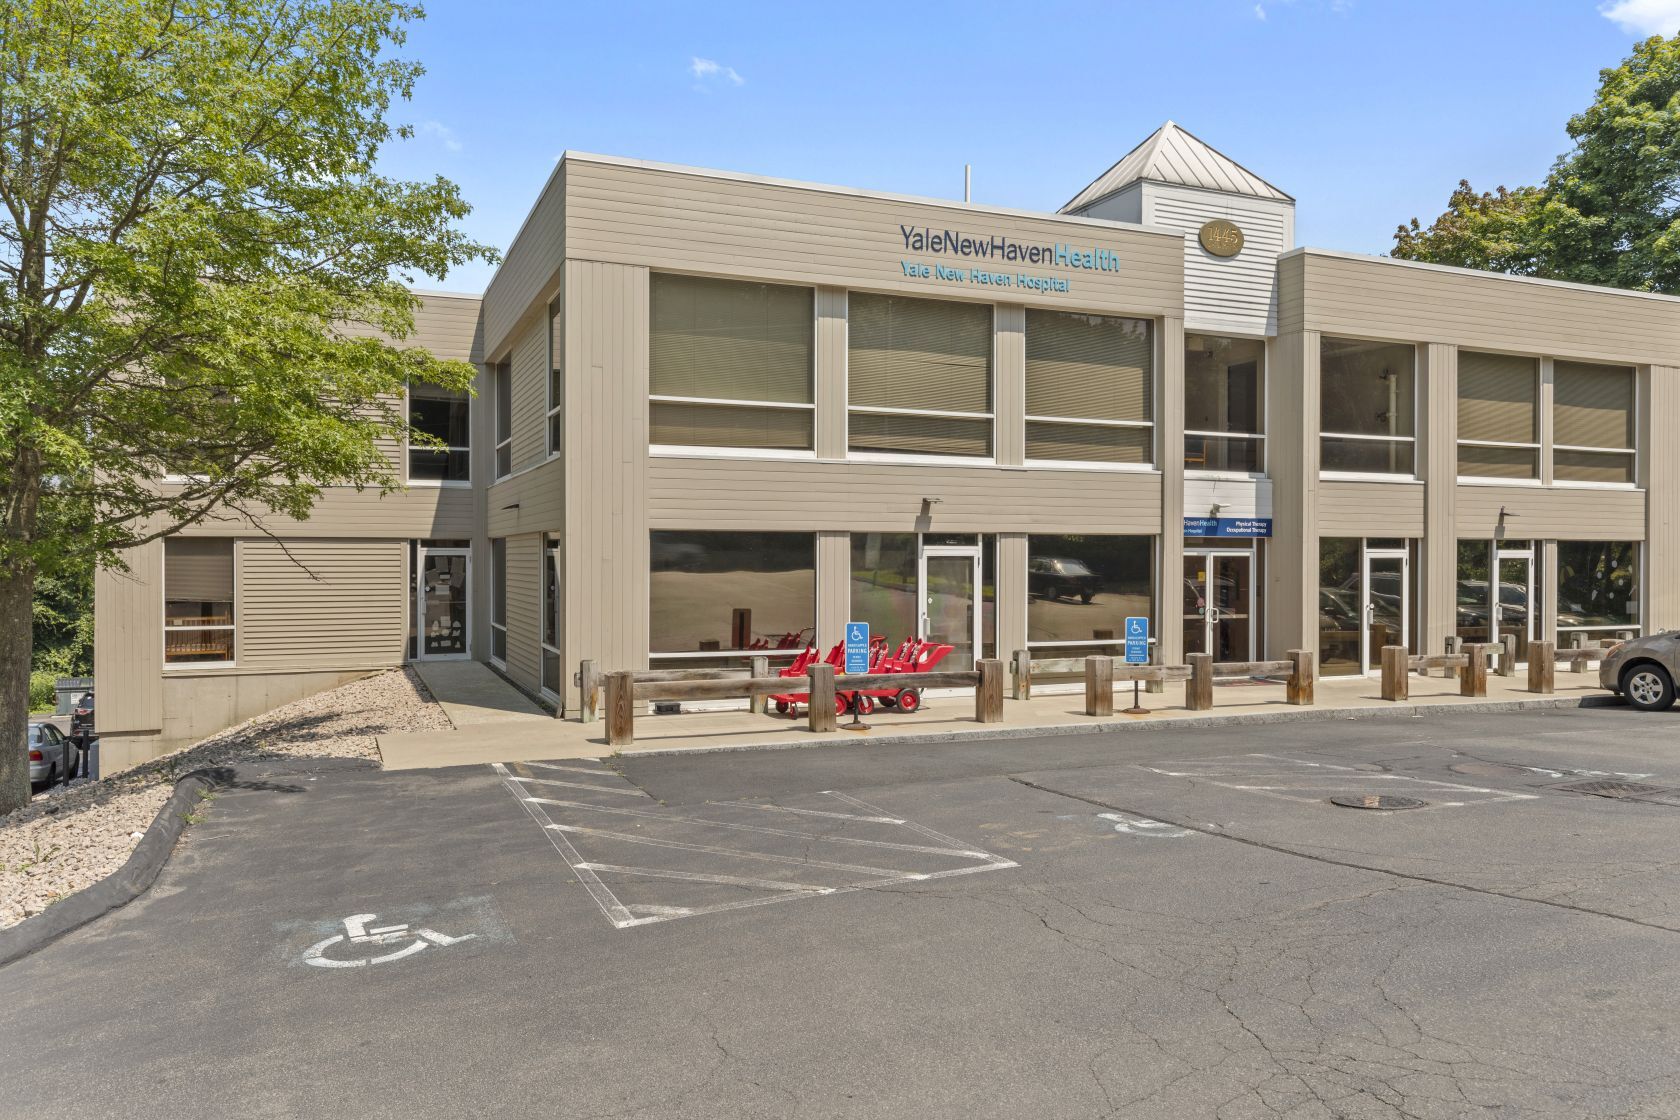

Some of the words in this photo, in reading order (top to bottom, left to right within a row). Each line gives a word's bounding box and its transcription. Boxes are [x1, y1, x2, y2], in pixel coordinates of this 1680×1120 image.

[900, 224, 1119, 272] YaleNewHavenHealth
[1207, 226, 1238, 244] 1445
[900, 259, 930, 278] Yale
[935, 262, 965, 282] New
[970, 267, 1011, 287] Haven
[1016, 272, 1071, 294] Hospital
